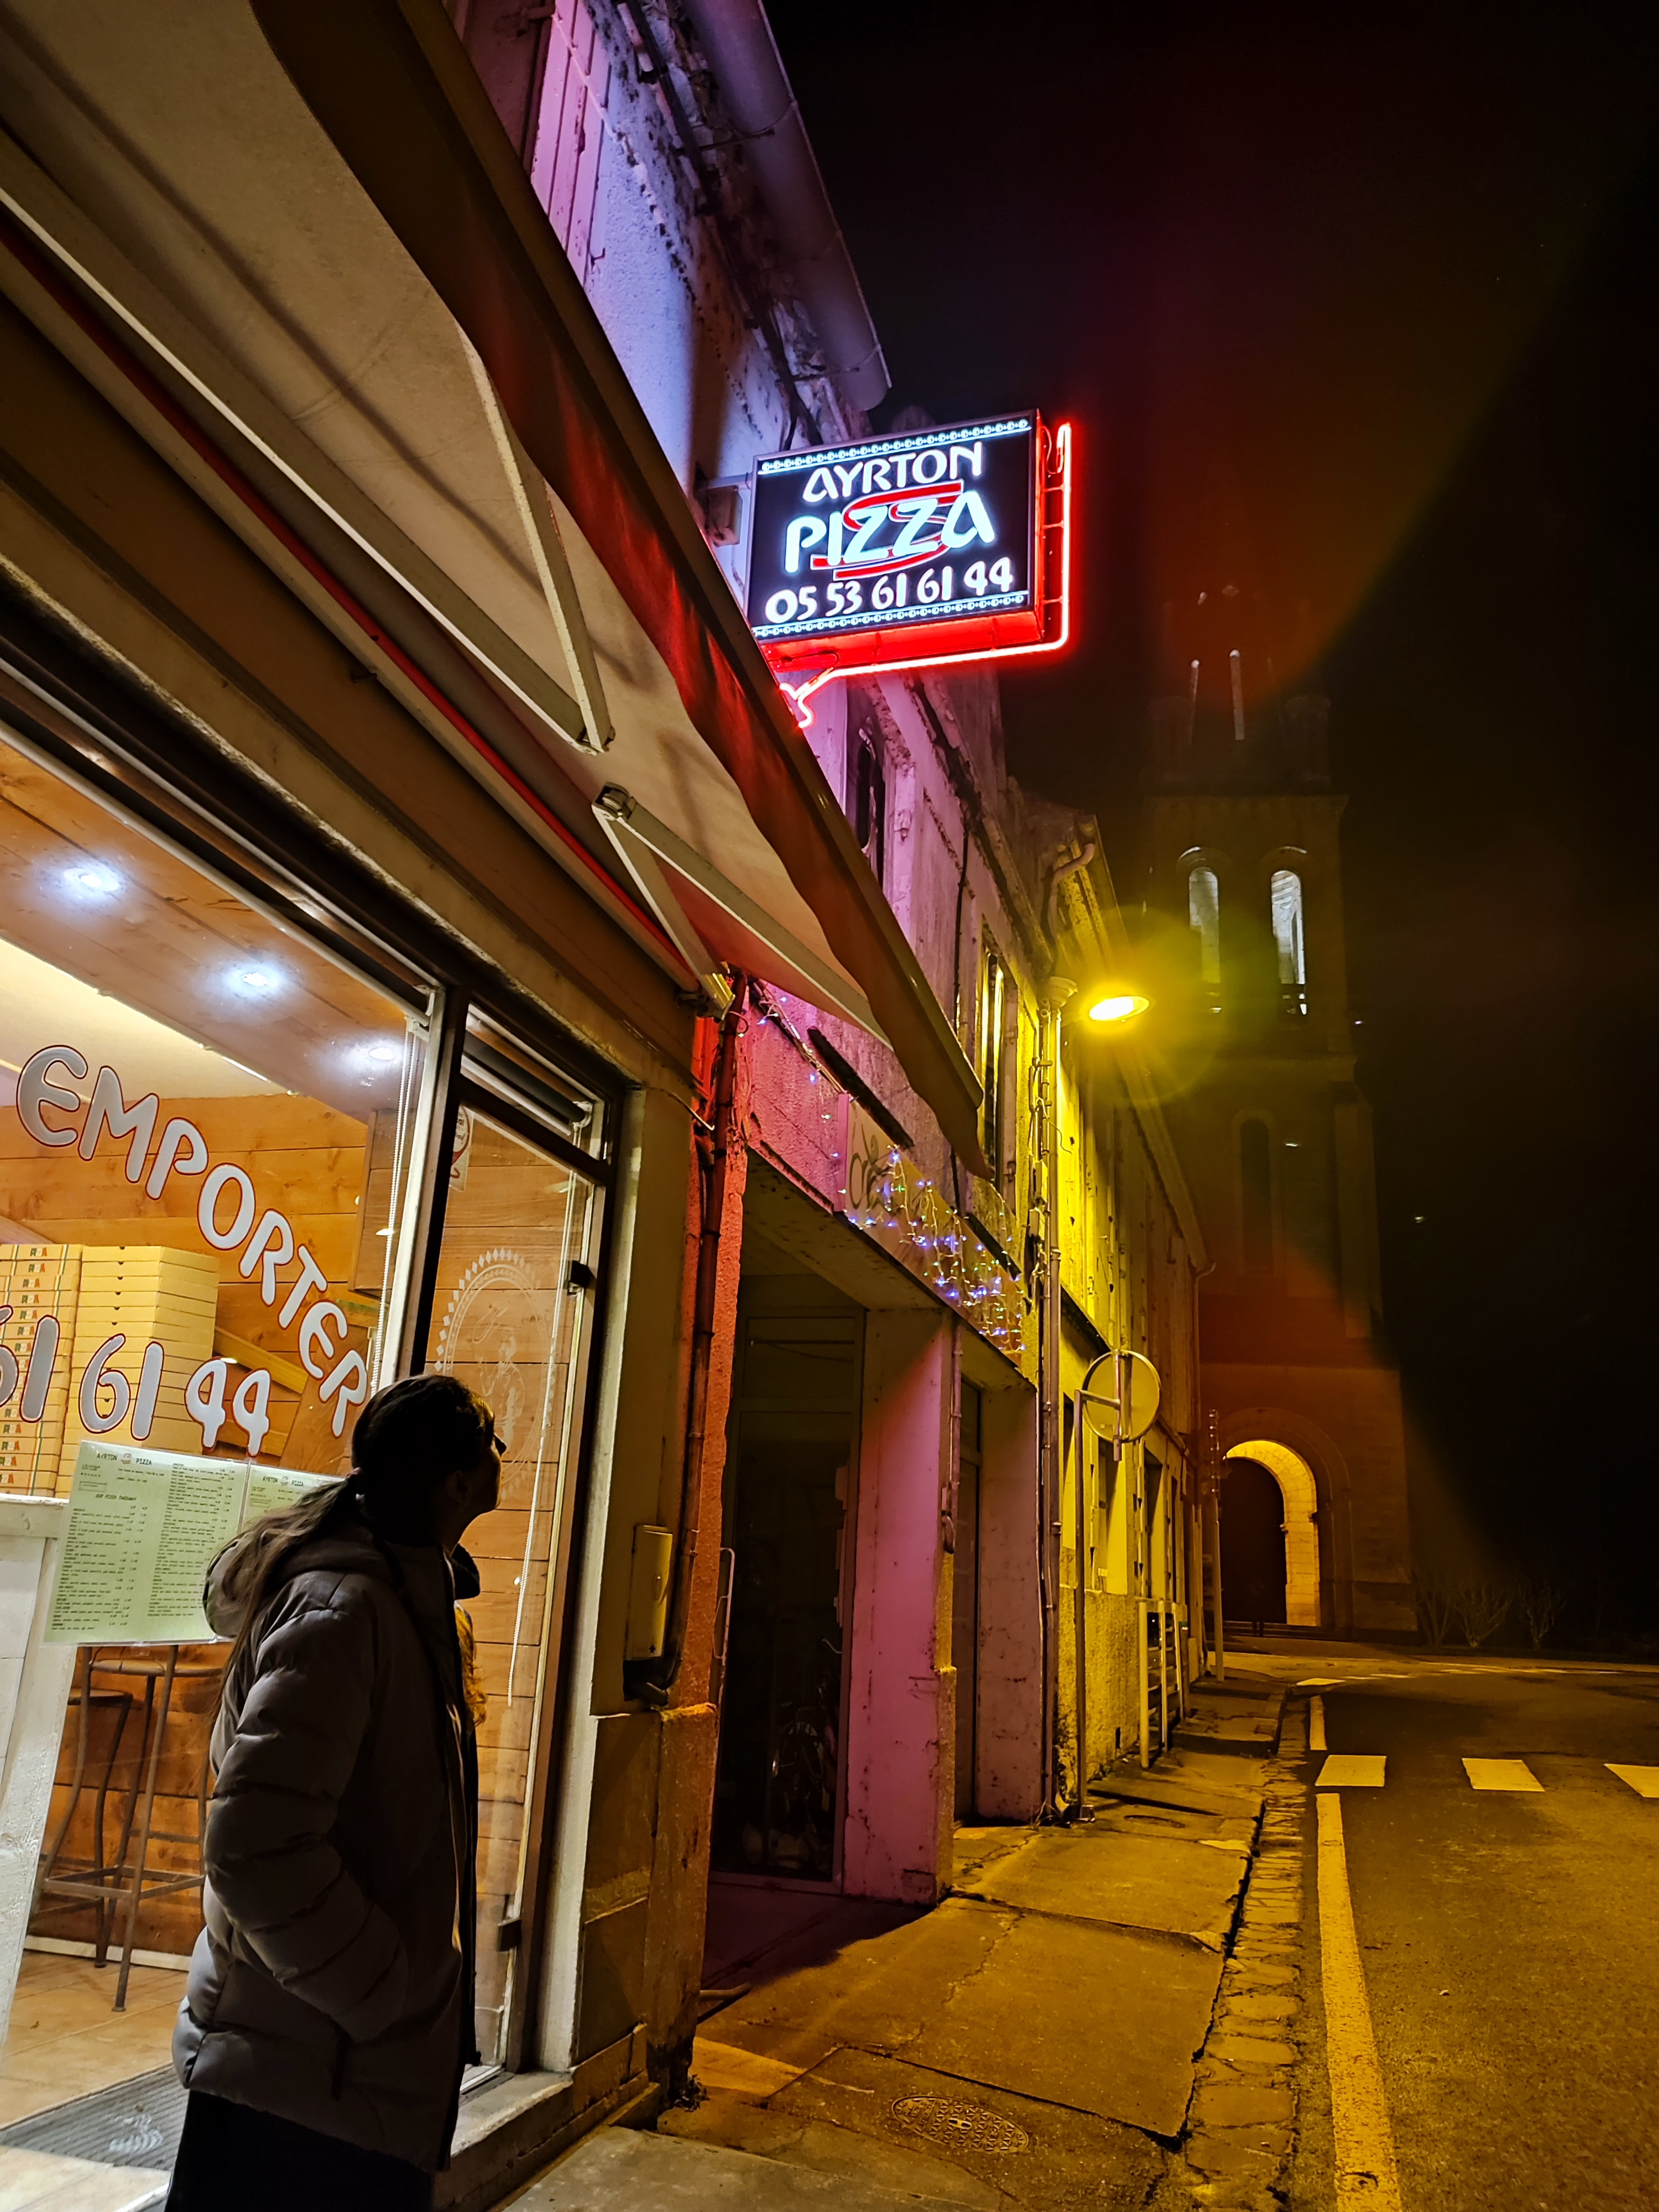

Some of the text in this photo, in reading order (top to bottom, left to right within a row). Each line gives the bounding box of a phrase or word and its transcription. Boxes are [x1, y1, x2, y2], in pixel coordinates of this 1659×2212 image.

[802, 441, 982, 503] AYRTON
[785, 490, 995, 573] PIZZA
[765, 557, 1014, 624] 05 53 61 61 44
[16, 1045, 368, 1437] EMPORTER
[79, 1333, 164, 1441] 61
[184, 1357, 270, 1457] 44
[96, 1453, 118, 1461] AYRTON
